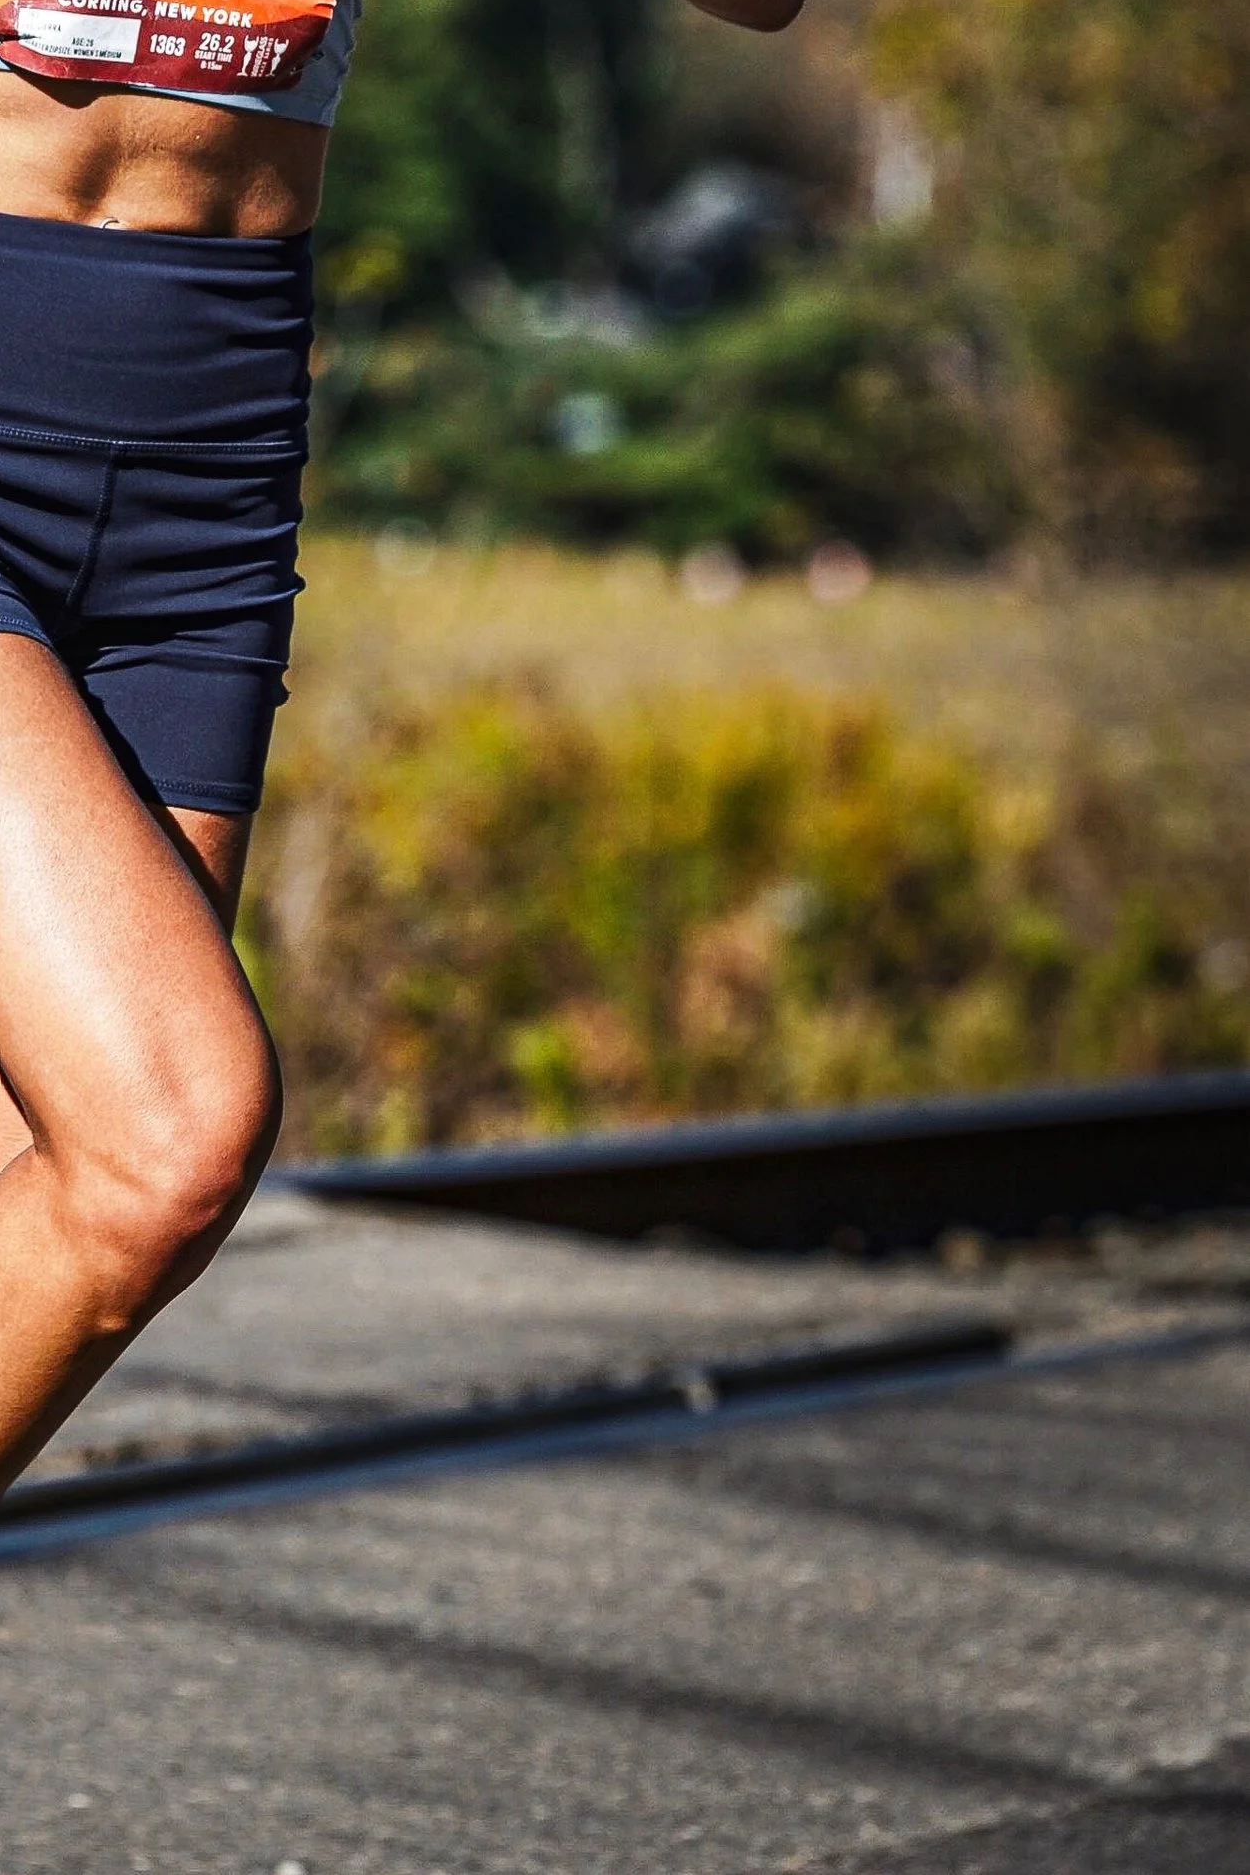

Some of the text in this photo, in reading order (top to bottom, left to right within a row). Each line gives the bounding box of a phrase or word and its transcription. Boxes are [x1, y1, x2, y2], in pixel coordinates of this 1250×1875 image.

[154, 1, 197, 21] NEW
[202, 7, 254, 29] YORK
[150, 34, 186, 57] 1363
[198, 32, 235, 53] 26.2
